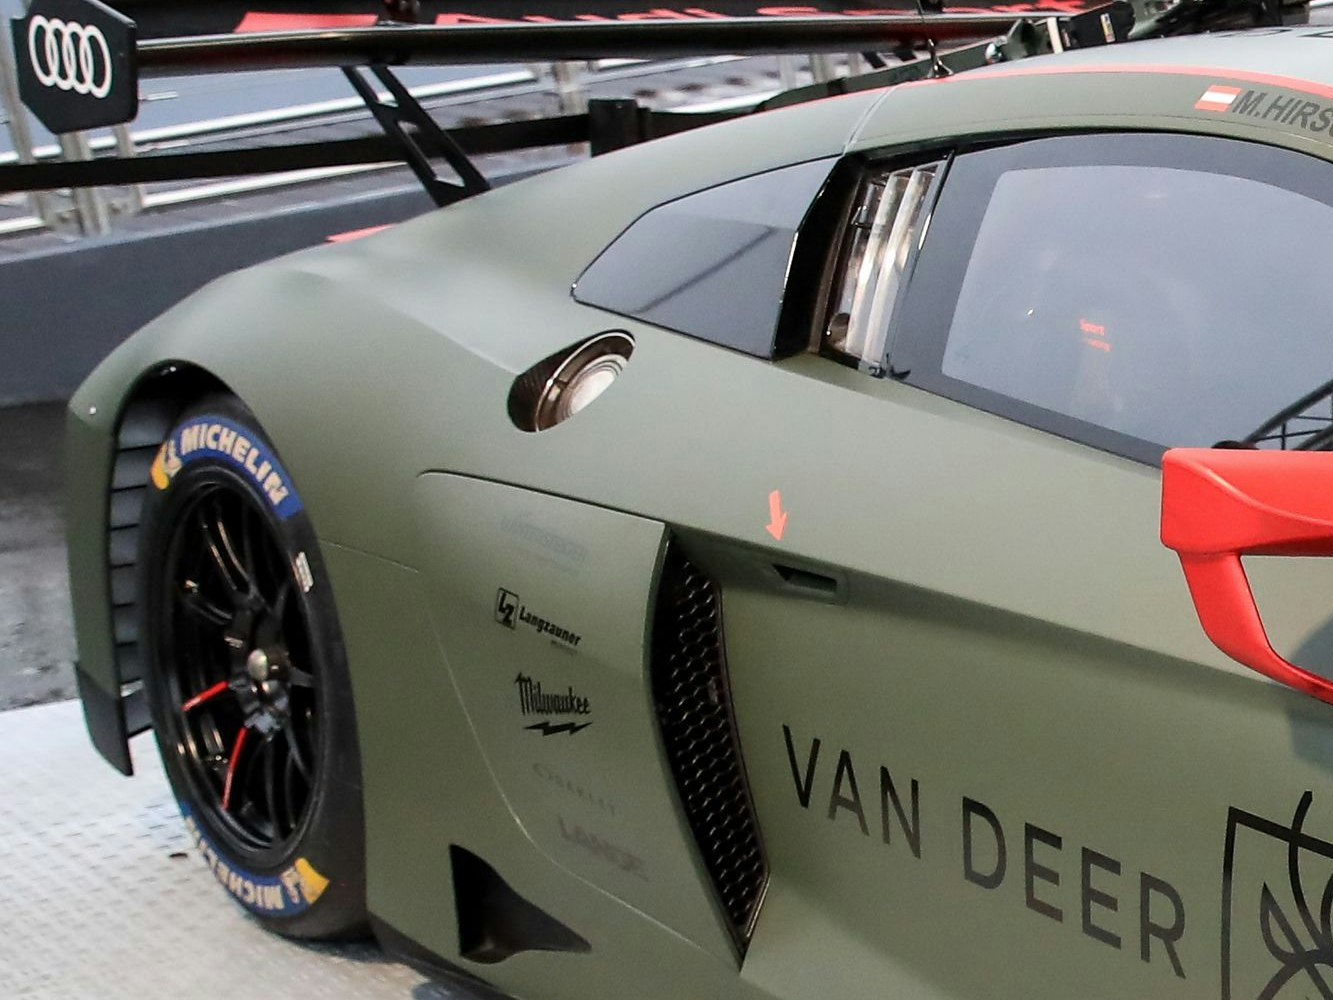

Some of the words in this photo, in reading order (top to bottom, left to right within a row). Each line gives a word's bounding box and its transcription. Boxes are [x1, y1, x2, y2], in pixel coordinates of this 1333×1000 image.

[181, 423, 289, 505] MICHELIN
[514, 672, 592, 716] Milwaukee
[782, 724, 922, 858] VAN
[961, 795, 1187, 979] DEER
